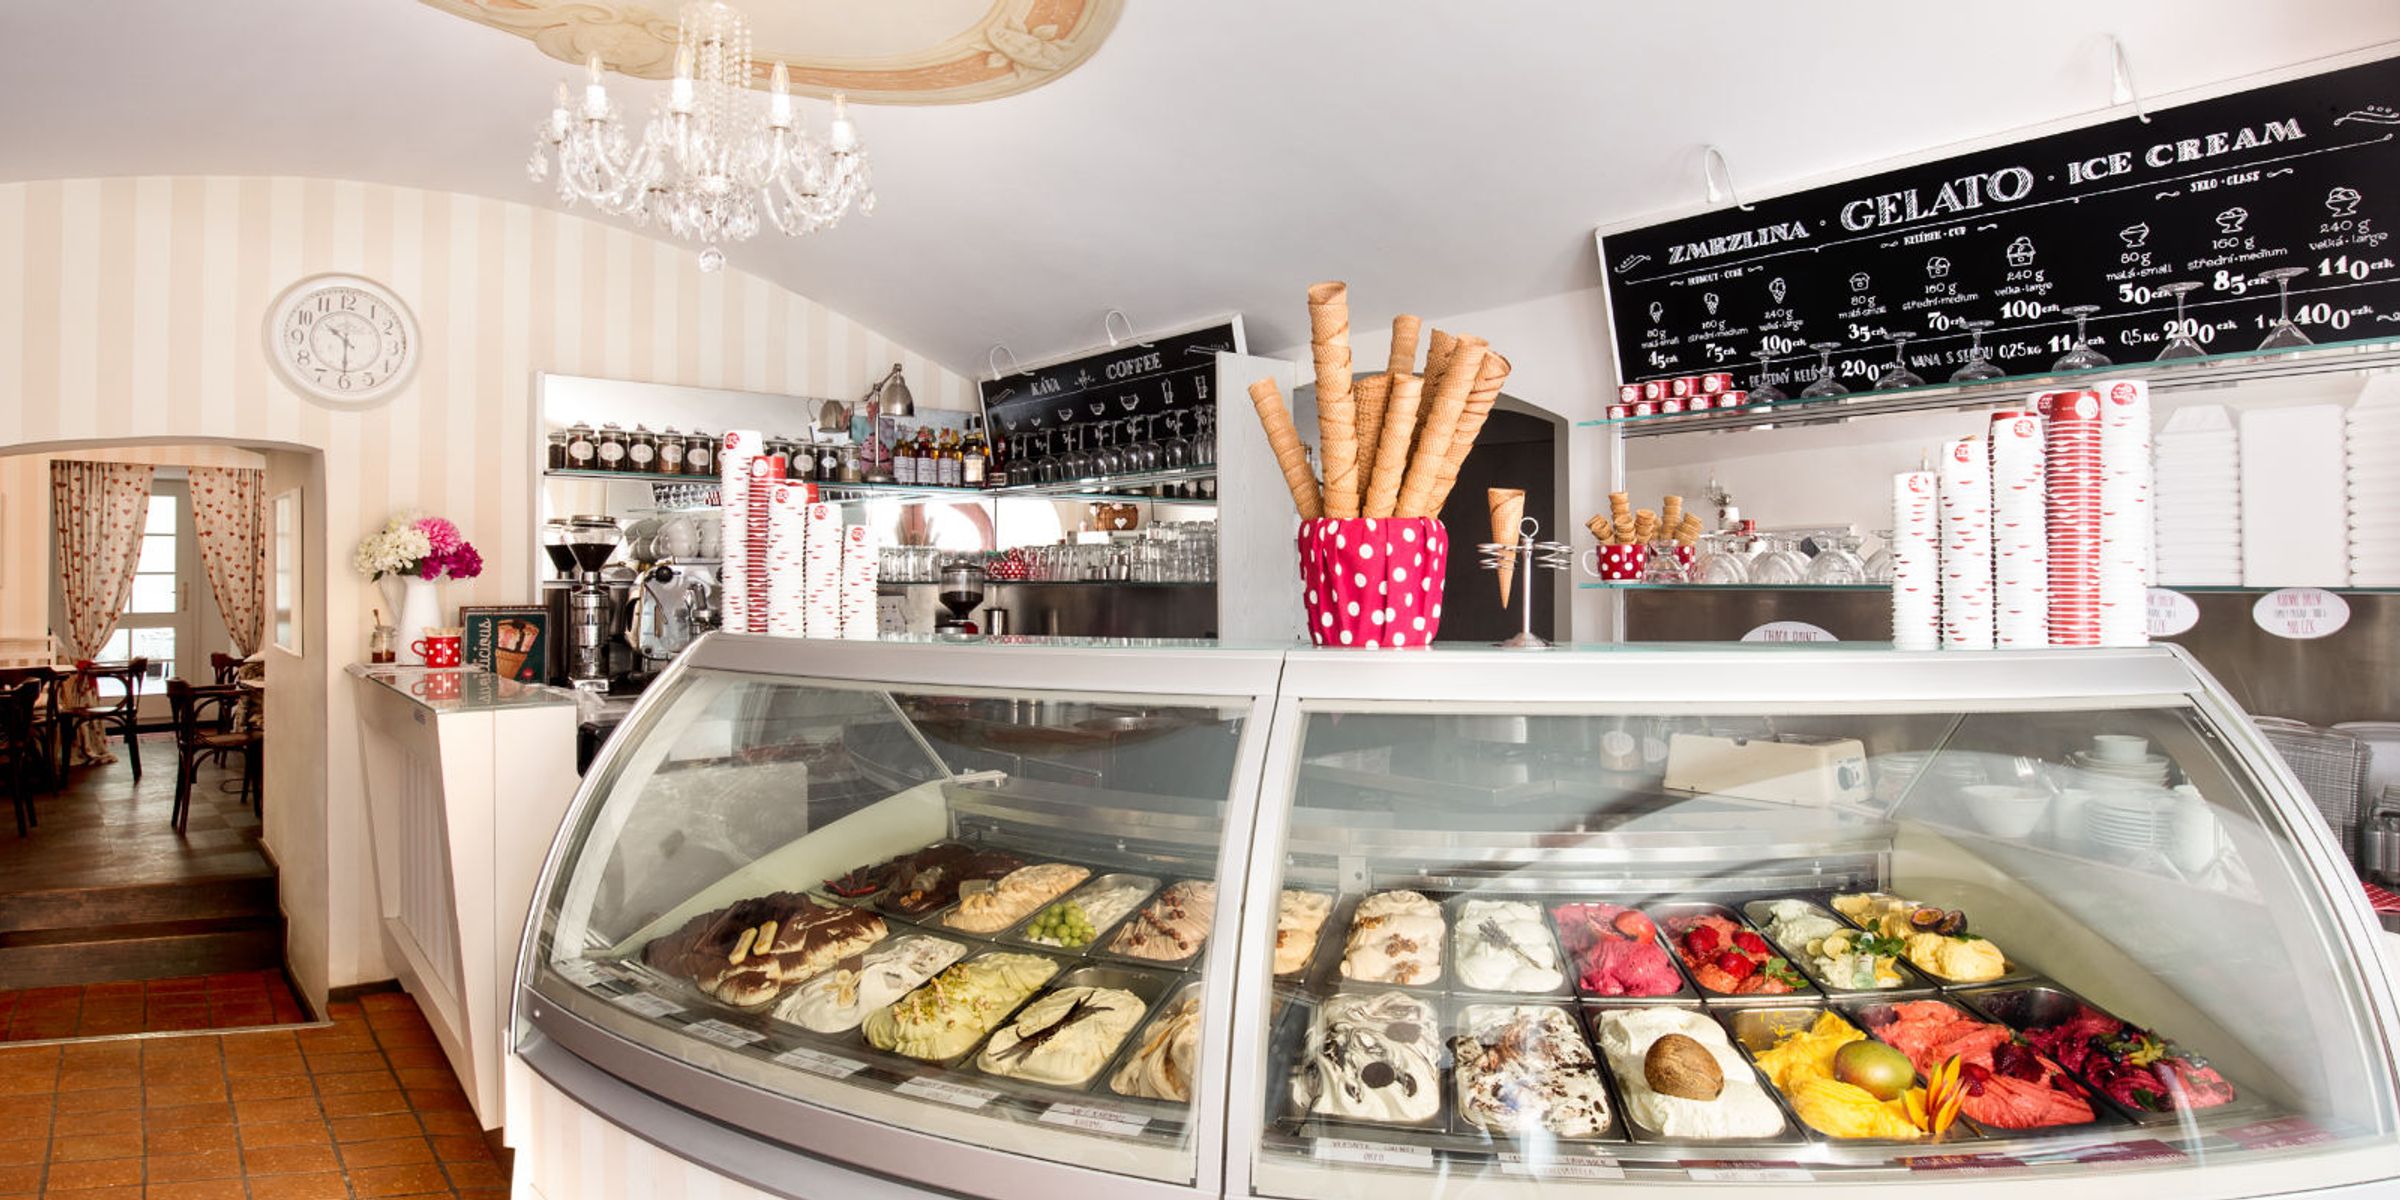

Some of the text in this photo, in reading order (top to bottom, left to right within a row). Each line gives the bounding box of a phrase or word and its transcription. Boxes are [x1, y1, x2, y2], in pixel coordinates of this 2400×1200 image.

[1668, 117, 2306, 264] ZMRZLINA GELATO ICE CREAM
[2319, 219, 2371, 234] 240 g
[2212, 237, 2239, 250] 160
[2006, 270, 2032, 281] 240
[317, 297, 330, 312] 11
[341, 294, 357, 311] 12
[298, 310, 313, 325] 10
[370, 304, 376, 319] 1
[382, 319, 394, 336] 2
[290, 329, 304, 345] 9
[386, 340, 399, 356] 3
[1945, 350, 1954, 364] S
[1956, 346, 1994, 363] SEOU
[296, 350, 311, 365] 8
[338, 374, 351, 390] 6
[1030, 352, 1162, 396] KÁVA COFFEE
